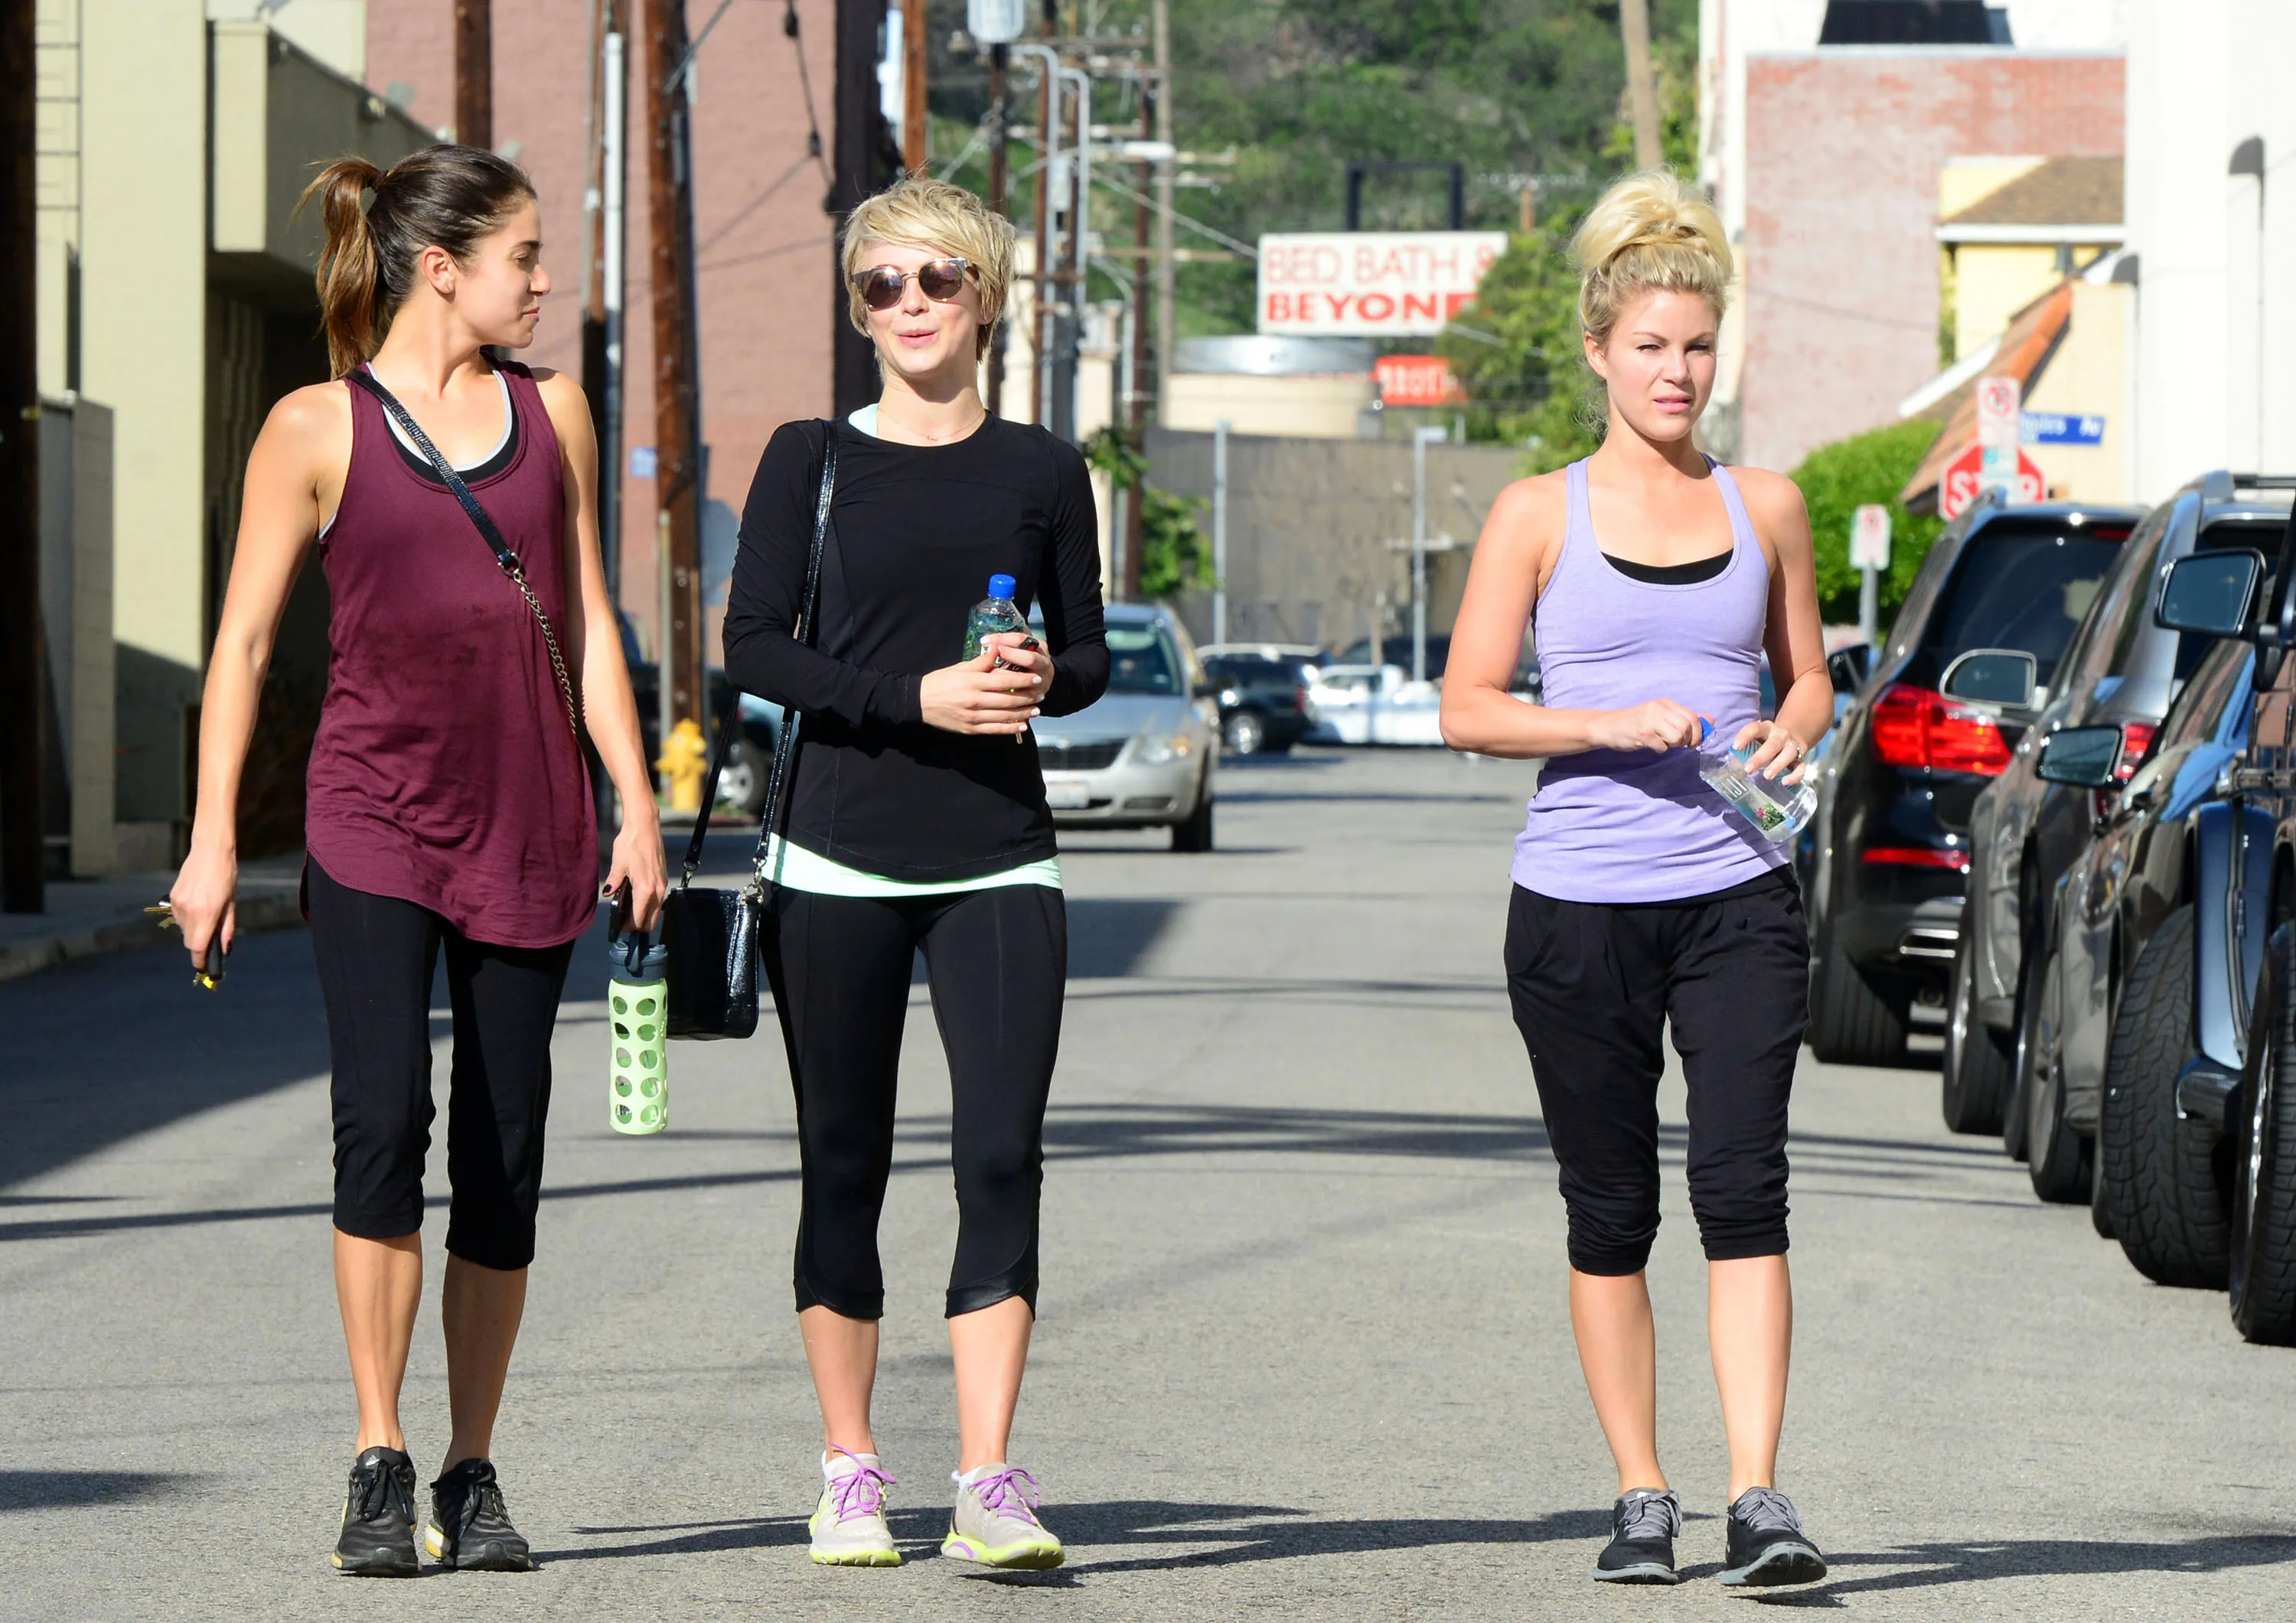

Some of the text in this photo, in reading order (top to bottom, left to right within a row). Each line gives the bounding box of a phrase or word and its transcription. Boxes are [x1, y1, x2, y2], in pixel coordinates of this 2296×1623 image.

[1266, 246, 1342, 285] BED
[1354, 244, 1458, 285] BATH
[1948, 471, 2039, 516] SP
